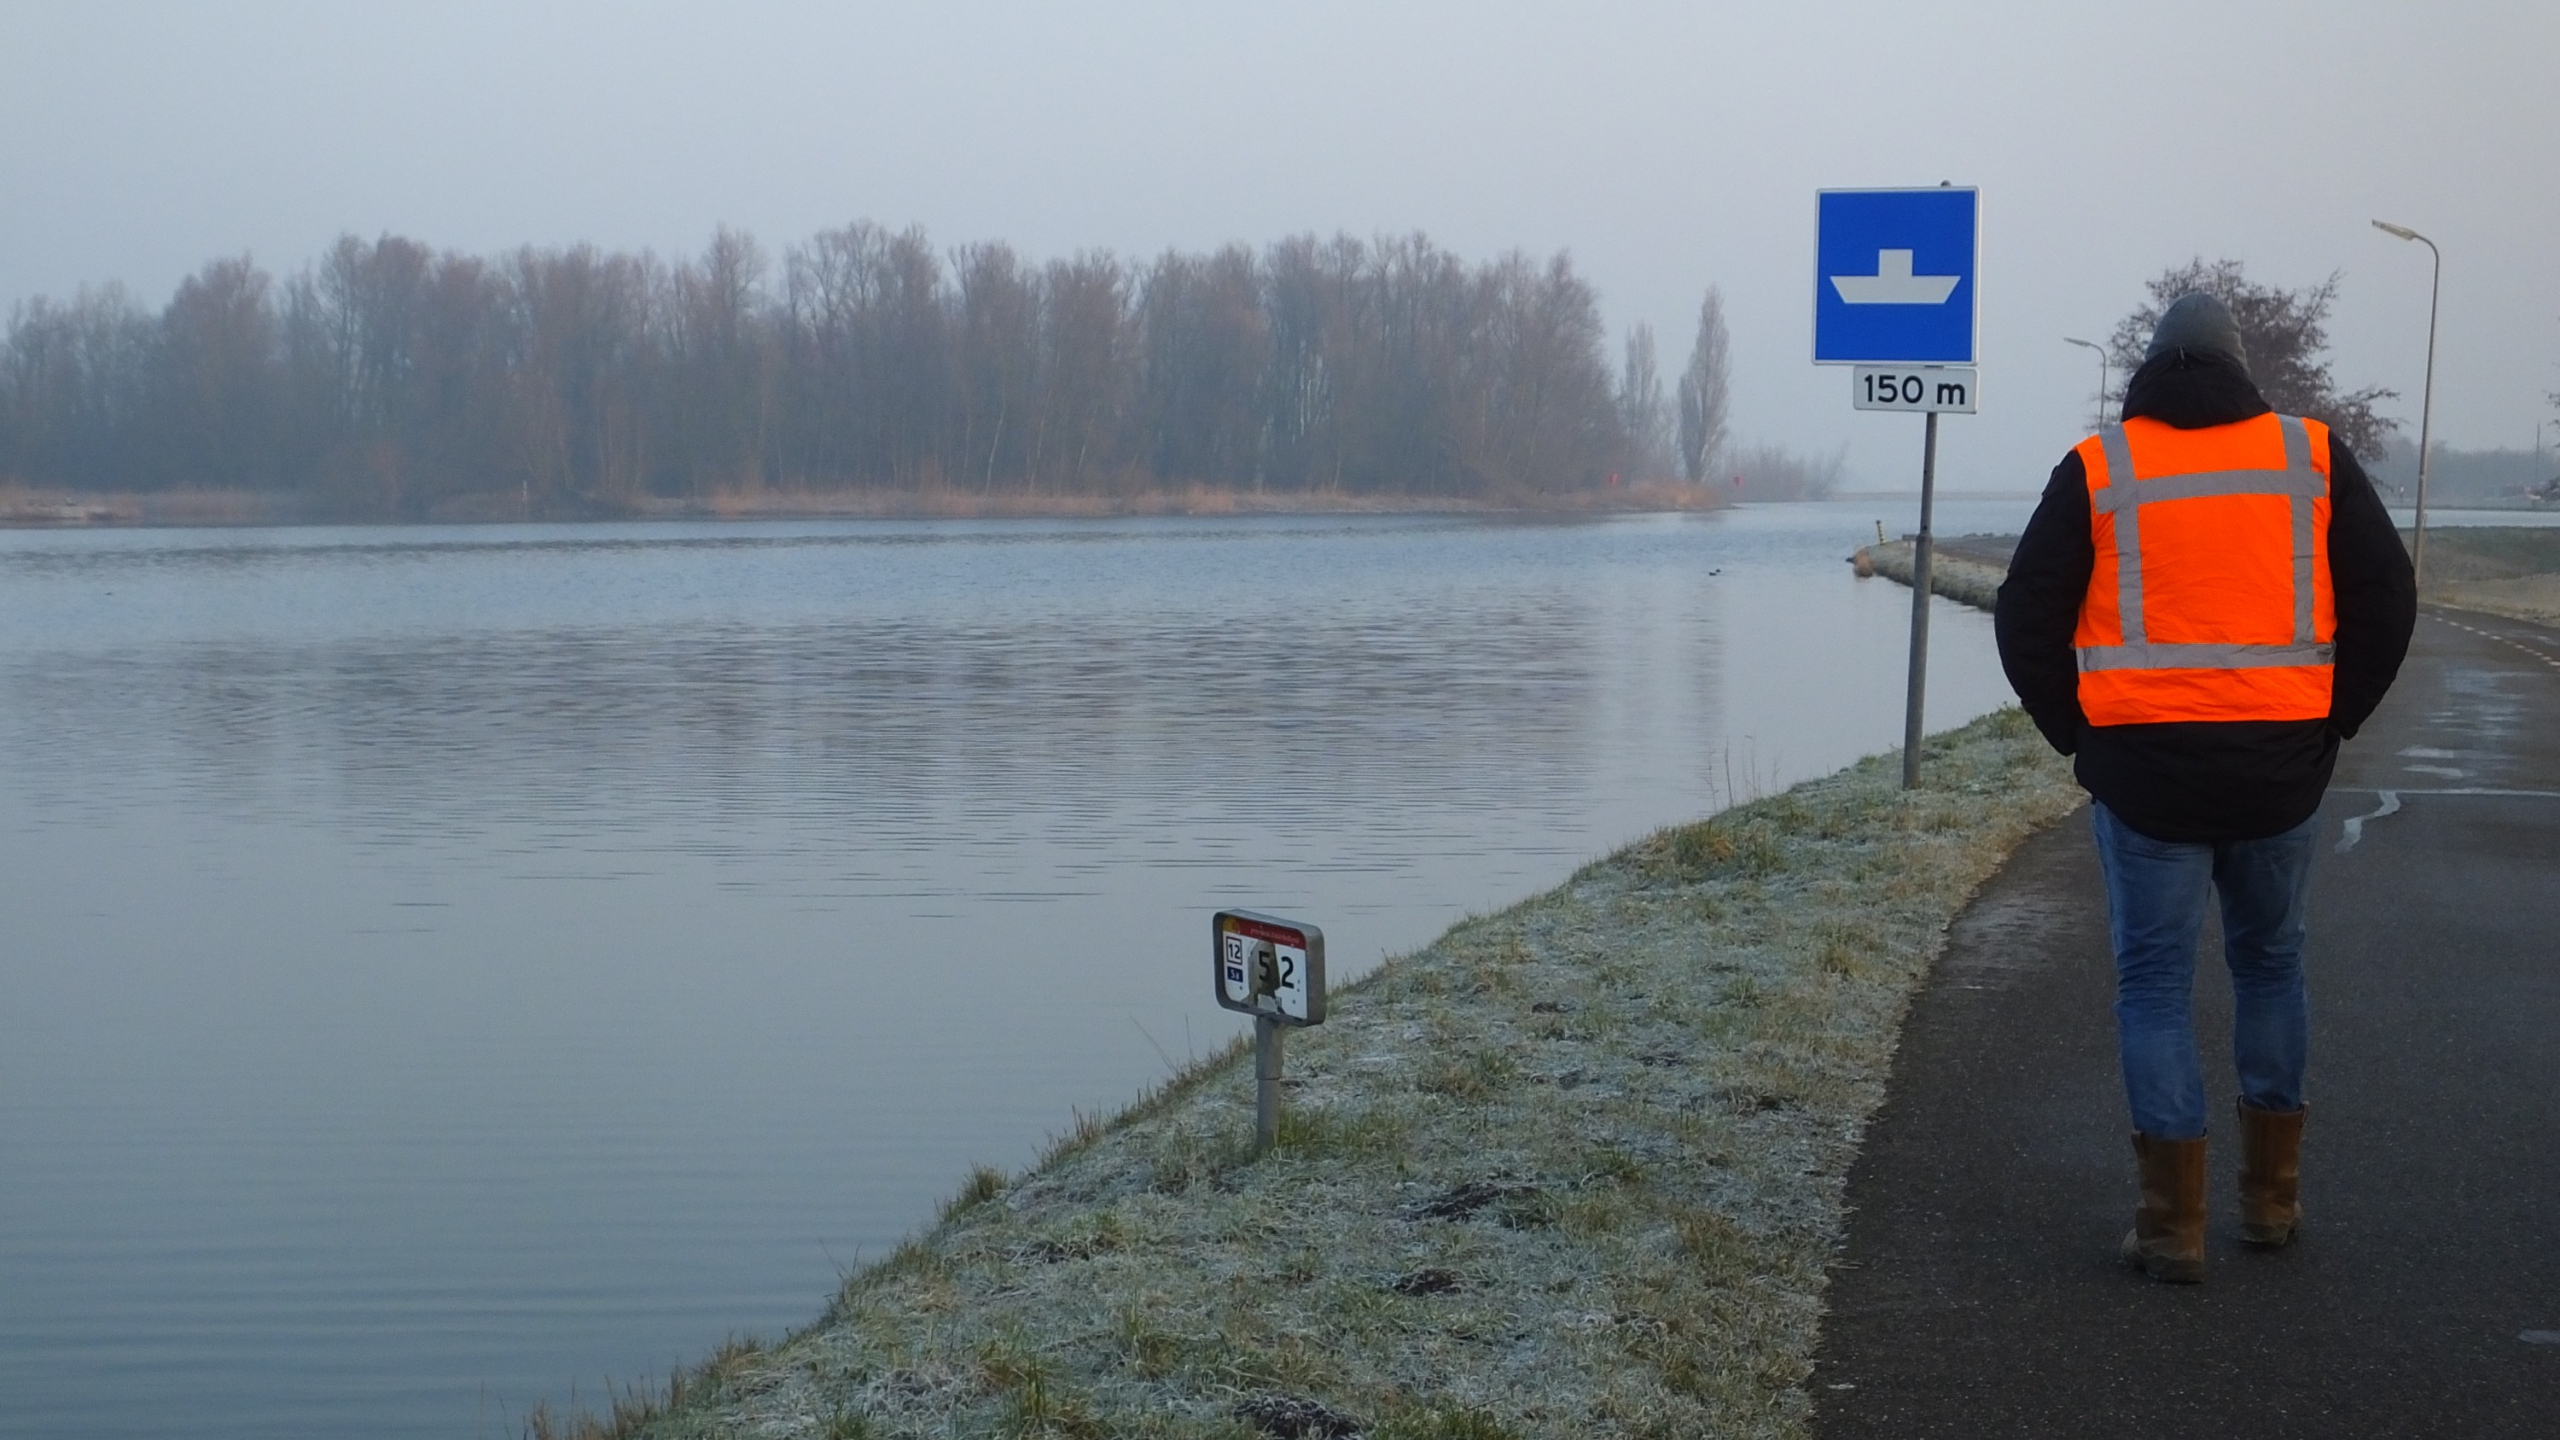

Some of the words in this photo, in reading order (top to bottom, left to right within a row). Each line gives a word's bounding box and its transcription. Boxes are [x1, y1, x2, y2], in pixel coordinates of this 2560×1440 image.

[1864, 374, 1924, 404] 150
[1936, 383, 1966, 405] m
[1228, 943, 1241, 960] 12
